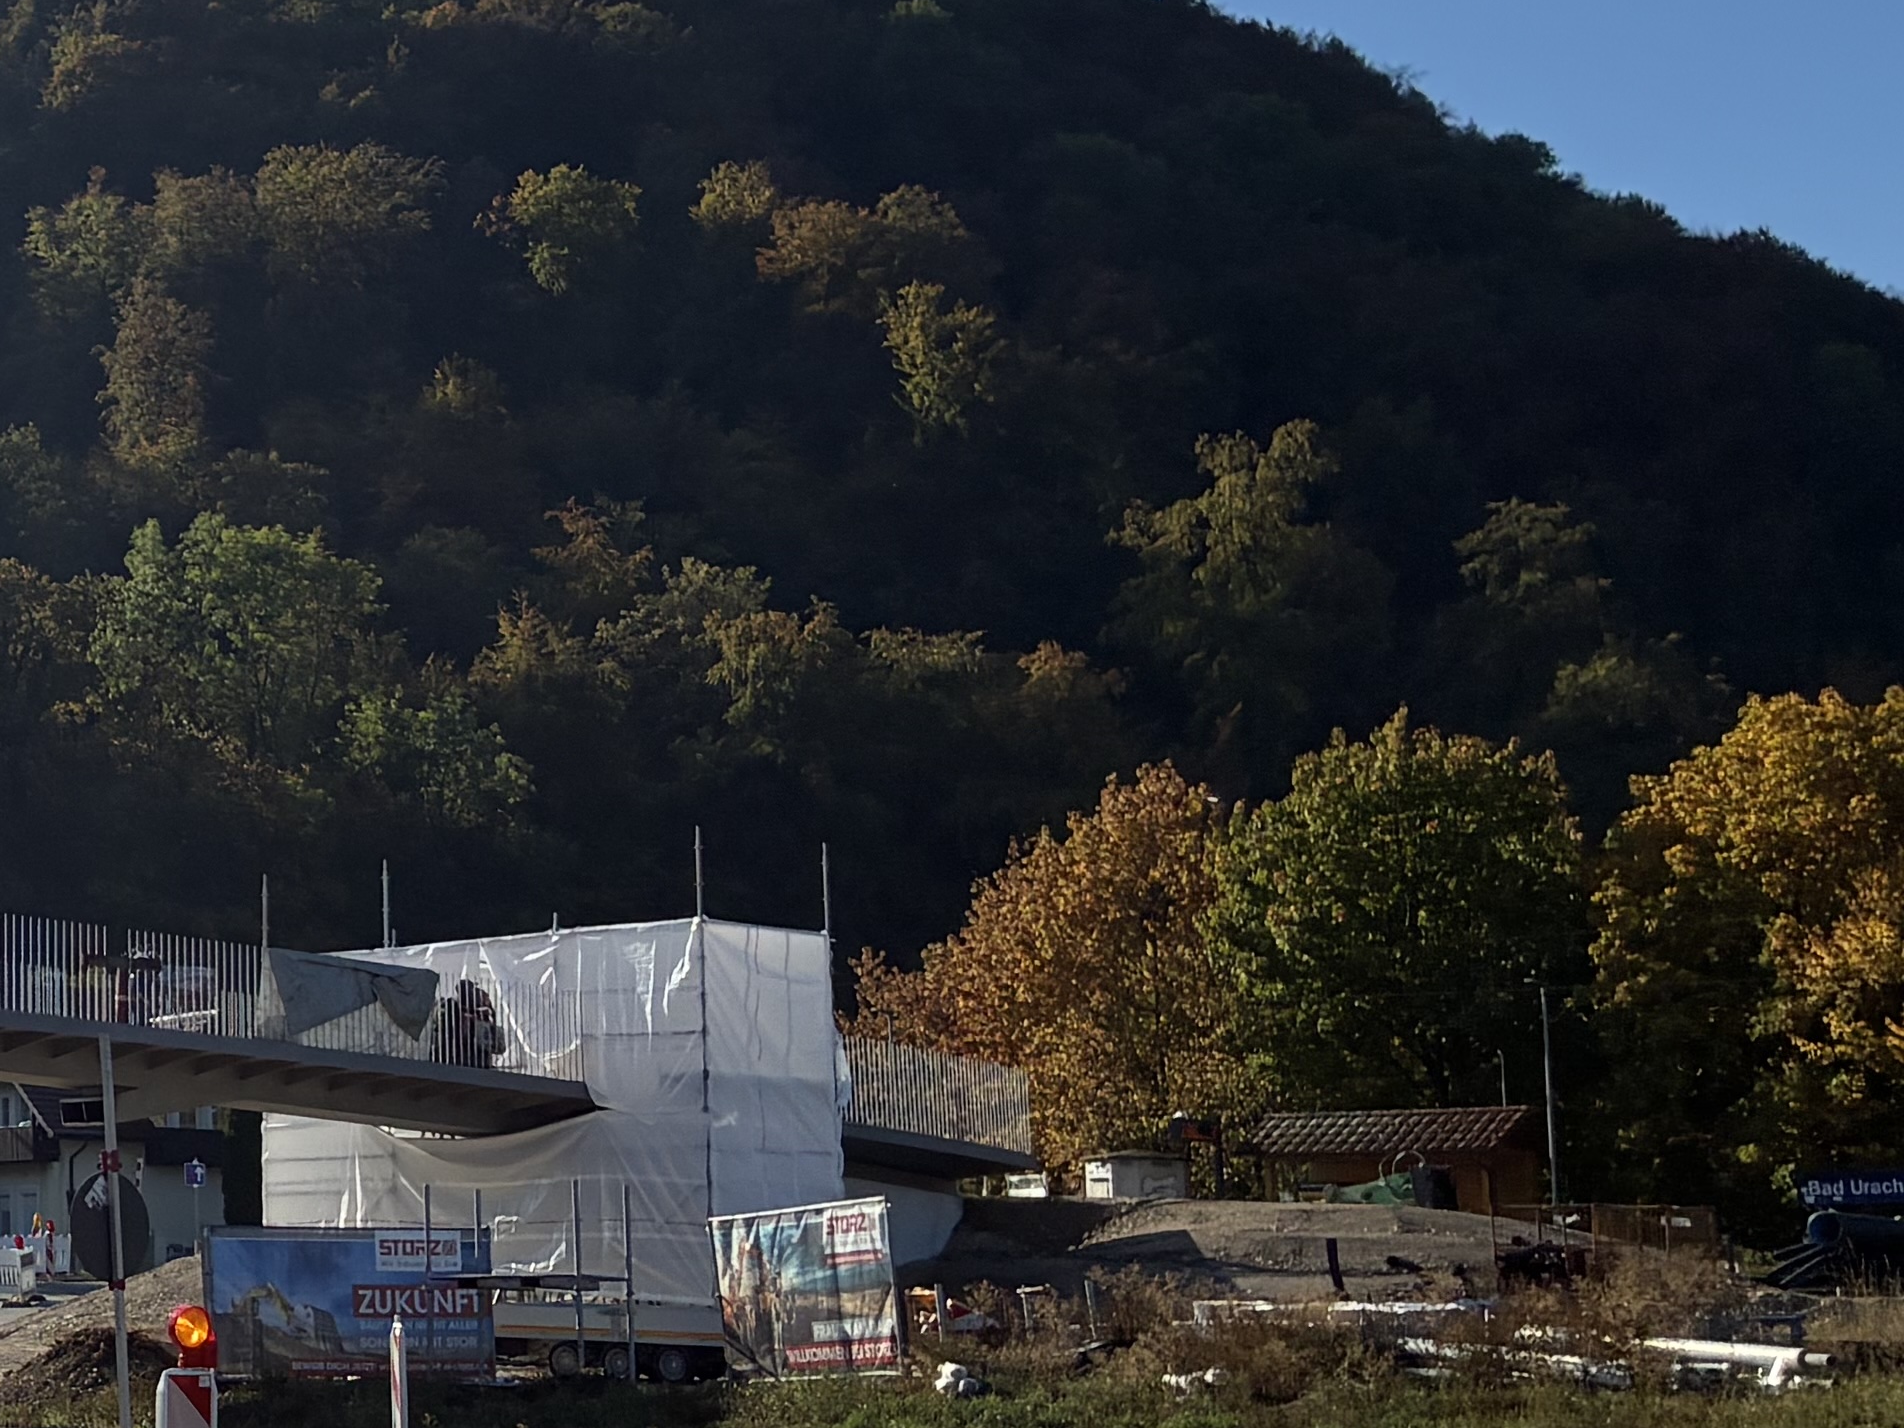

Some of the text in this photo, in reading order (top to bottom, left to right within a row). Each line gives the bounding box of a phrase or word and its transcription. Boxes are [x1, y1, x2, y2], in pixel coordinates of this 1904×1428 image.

[1808, 1178, 1904, 1196] Bad Urach
[379, 1239, 441, 1256] STORZ
